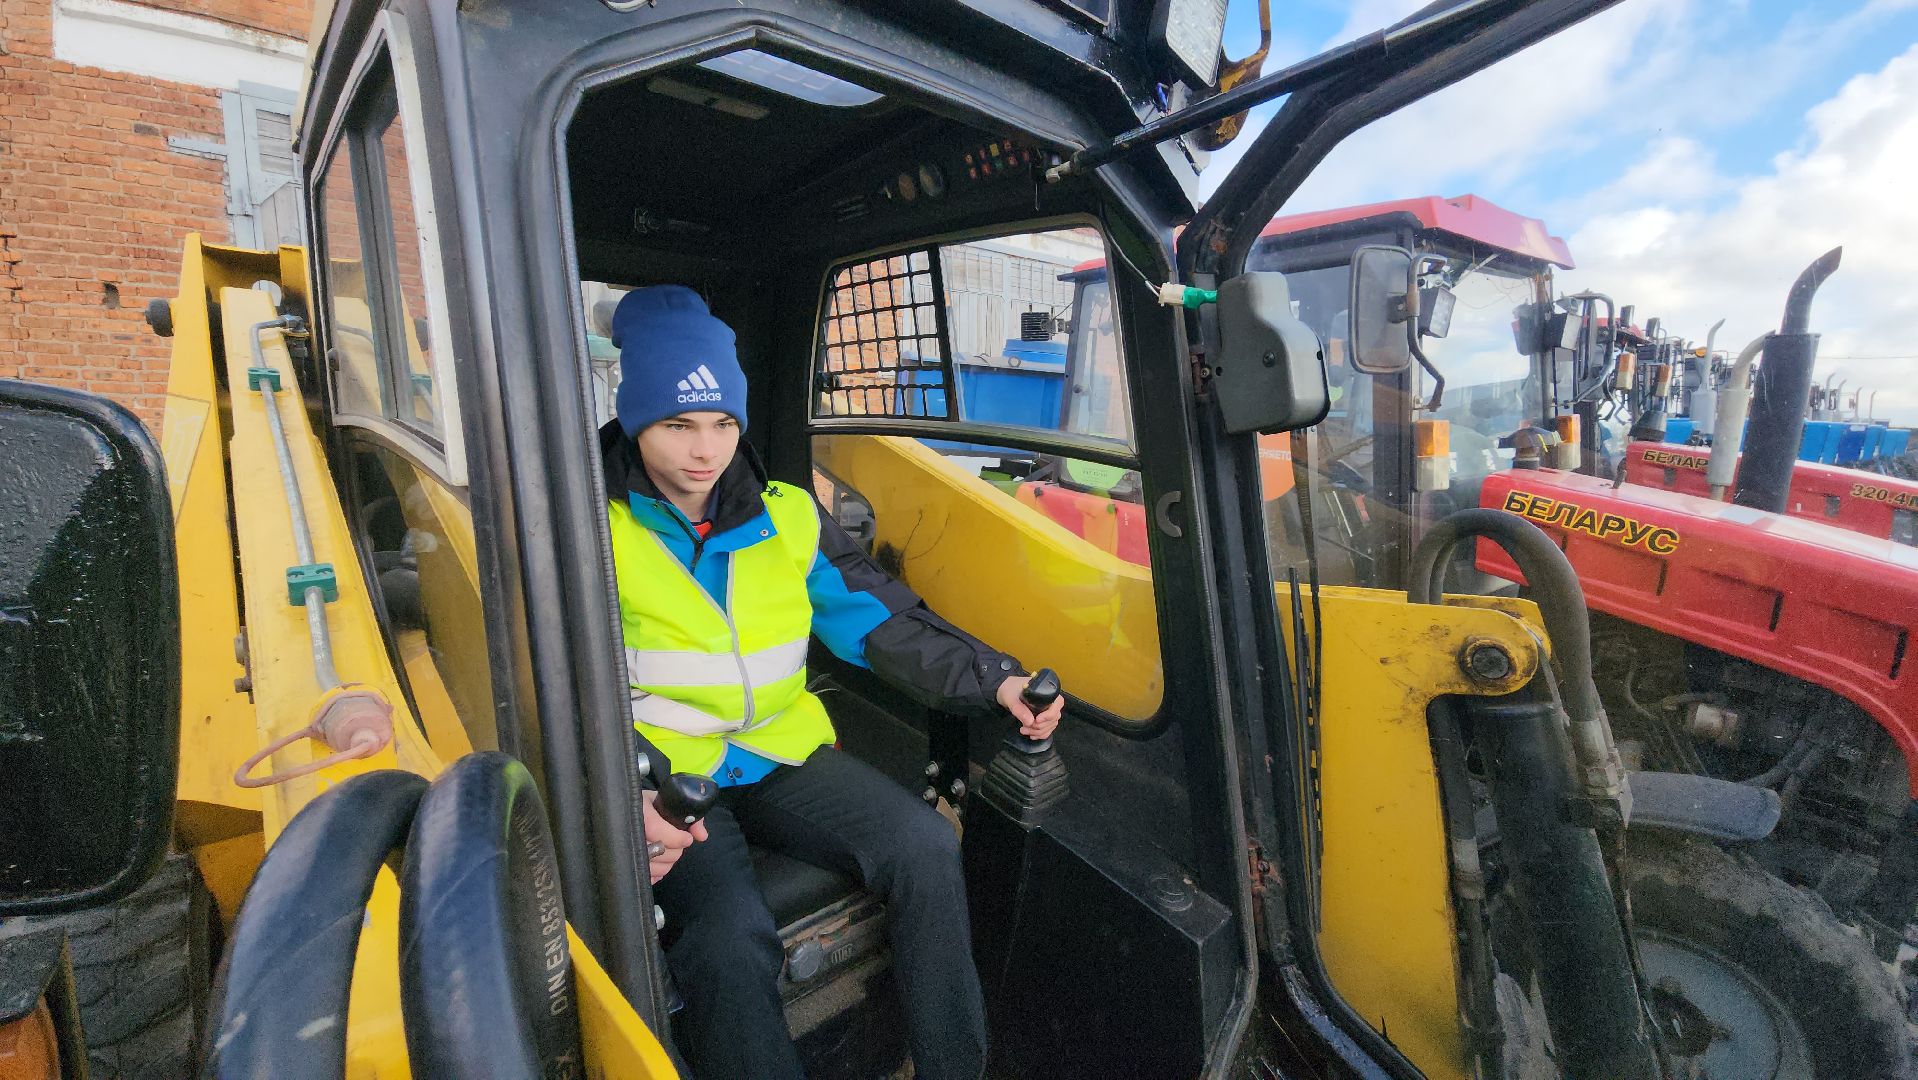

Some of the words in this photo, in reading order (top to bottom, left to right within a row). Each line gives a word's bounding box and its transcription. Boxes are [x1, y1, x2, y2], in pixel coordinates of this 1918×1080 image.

[677, 390, 722, 403] adidas
[1502, 489, 1680, 555] БЕЛАРУС
[543, 934, 564, 971] EN
[547, 969, 569, 1017] DIN
